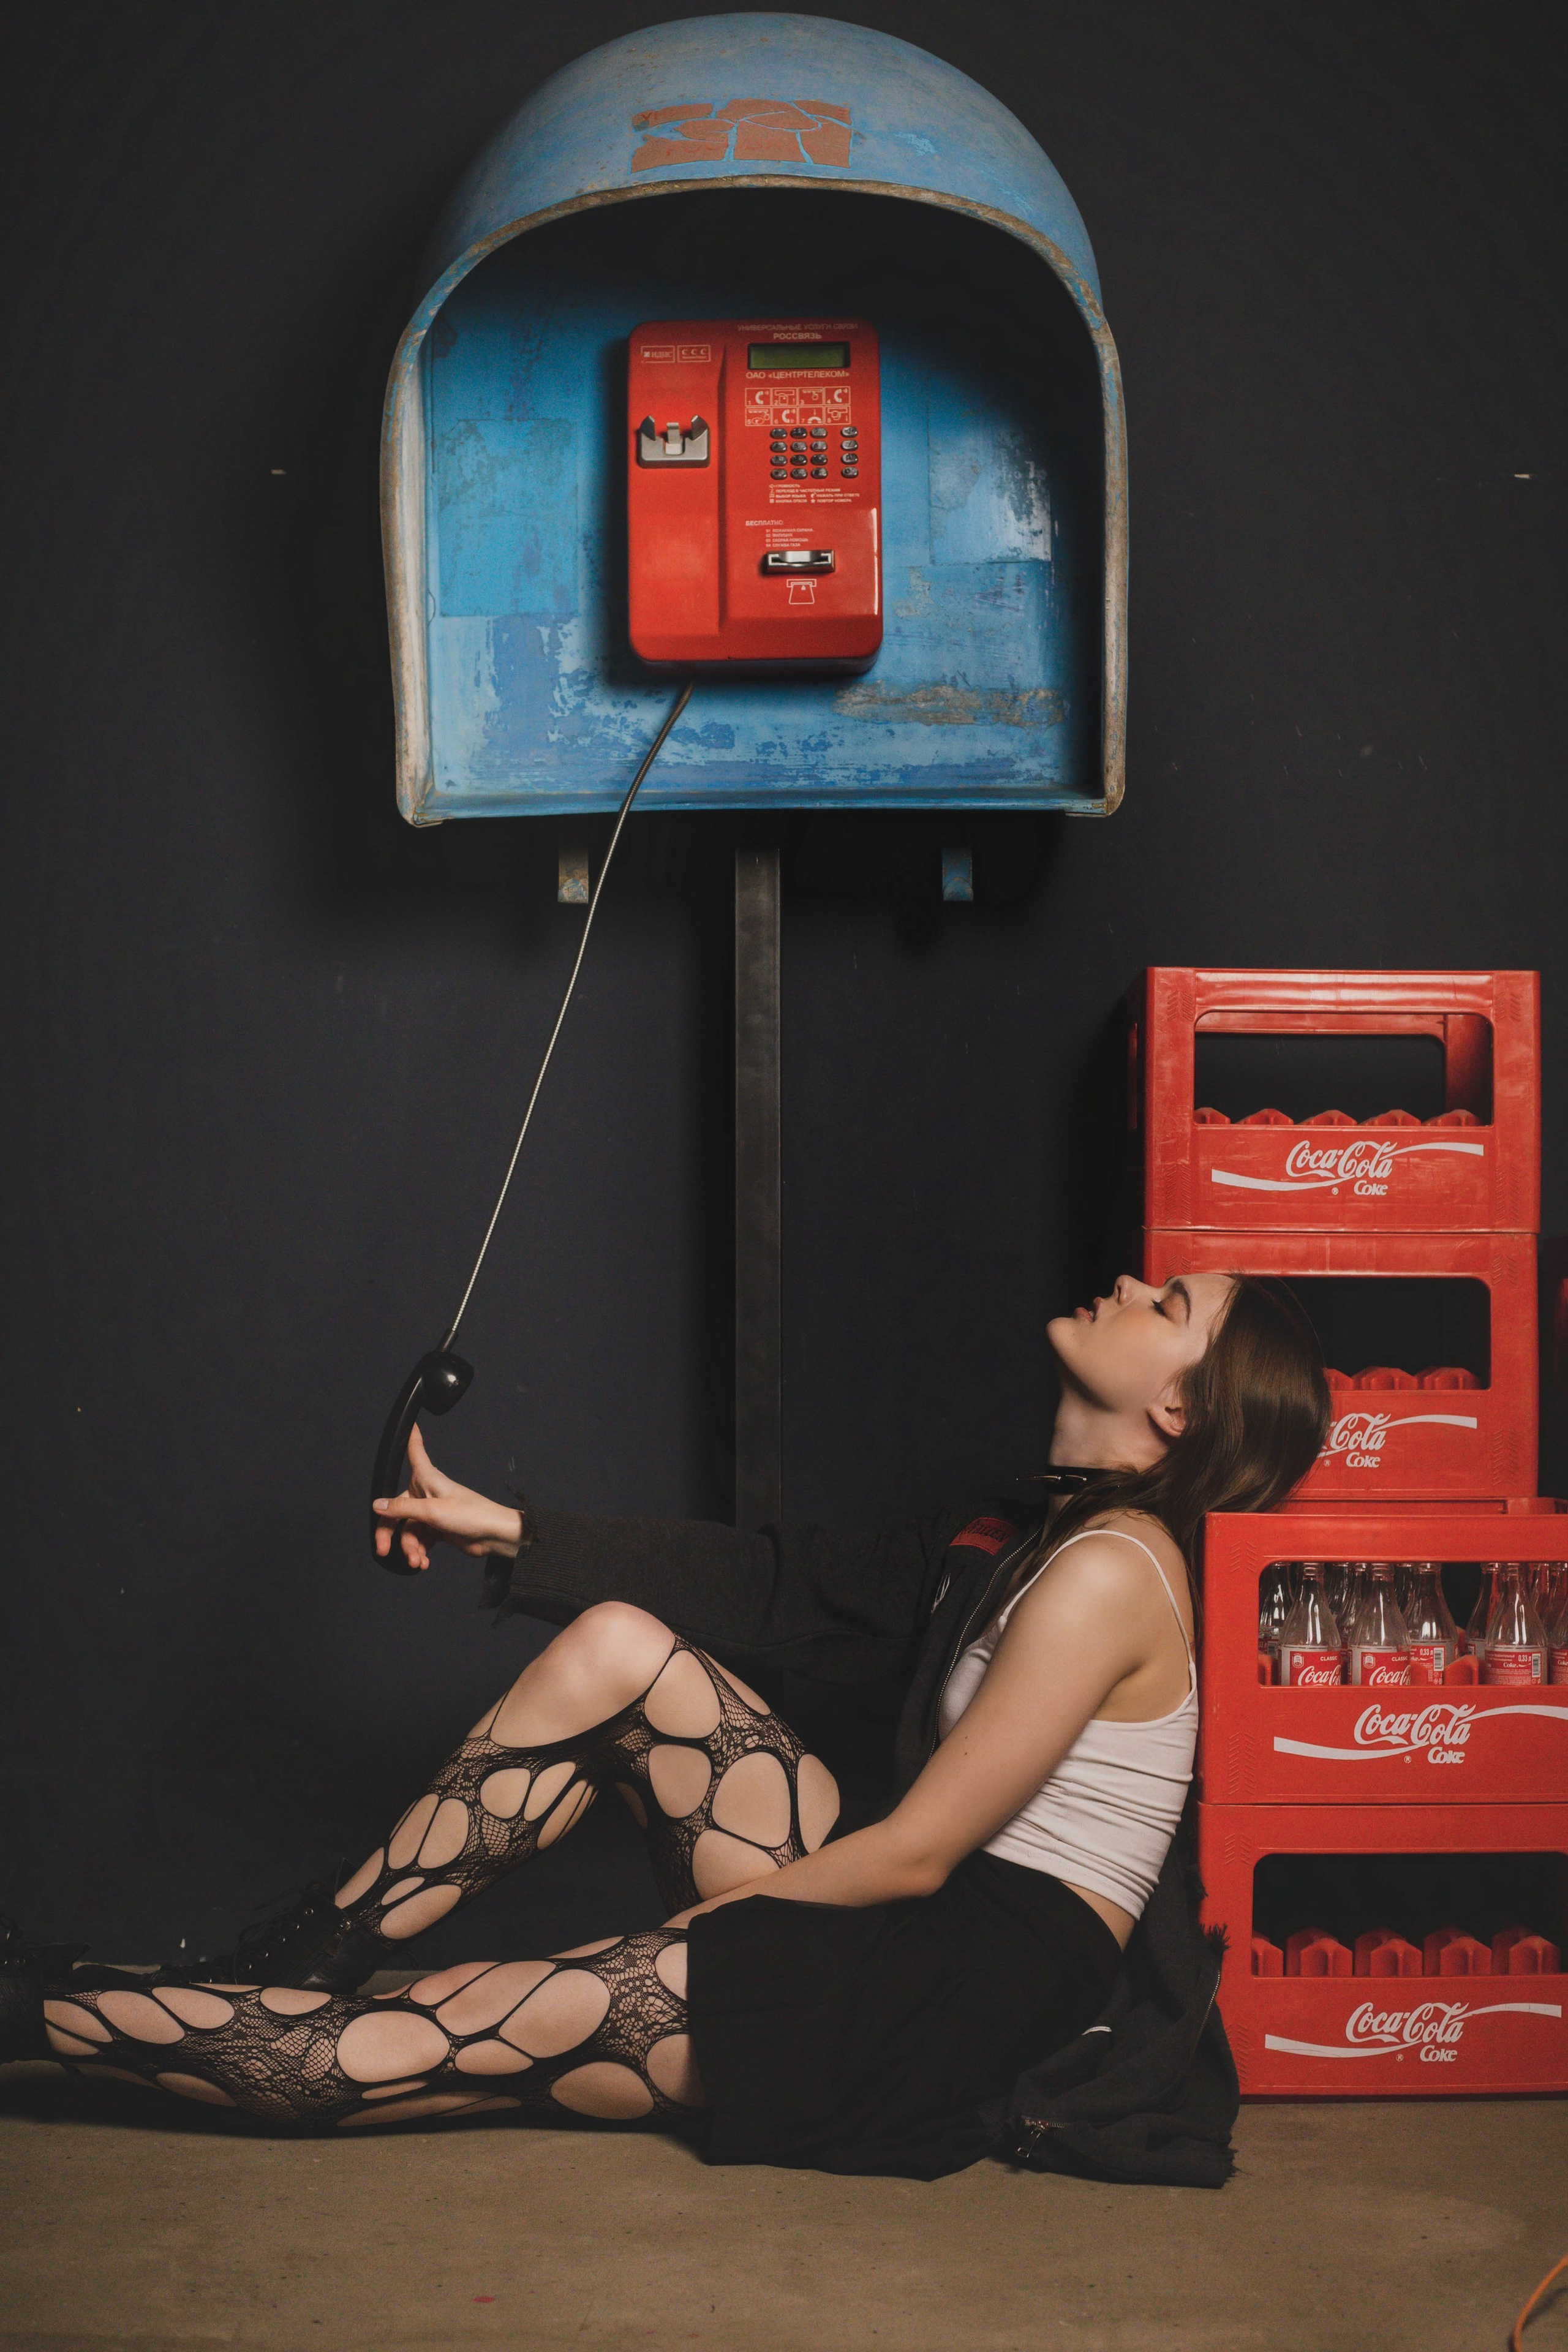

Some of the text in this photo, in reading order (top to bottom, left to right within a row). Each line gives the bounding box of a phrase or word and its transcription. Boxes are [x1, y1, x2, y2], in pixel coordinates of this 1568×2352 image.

[768, 371, 850, 380] «ЦЕНТРТЕЛЕКОМ»
[1286, 1140, 1398, 1178] Coca-Cola
[1354, 1180, 1388, 1196] Coke
[1346, 1452, 1381, 1468] Coke
[1354, 1704, 1476, 1745] Coca-Cola
[1428, 1746, 1465, 1764] Coke
[1345, 2002, 1469, 2043] Coca-Cola
[1420, 2045, 1458, 2062] Coke
